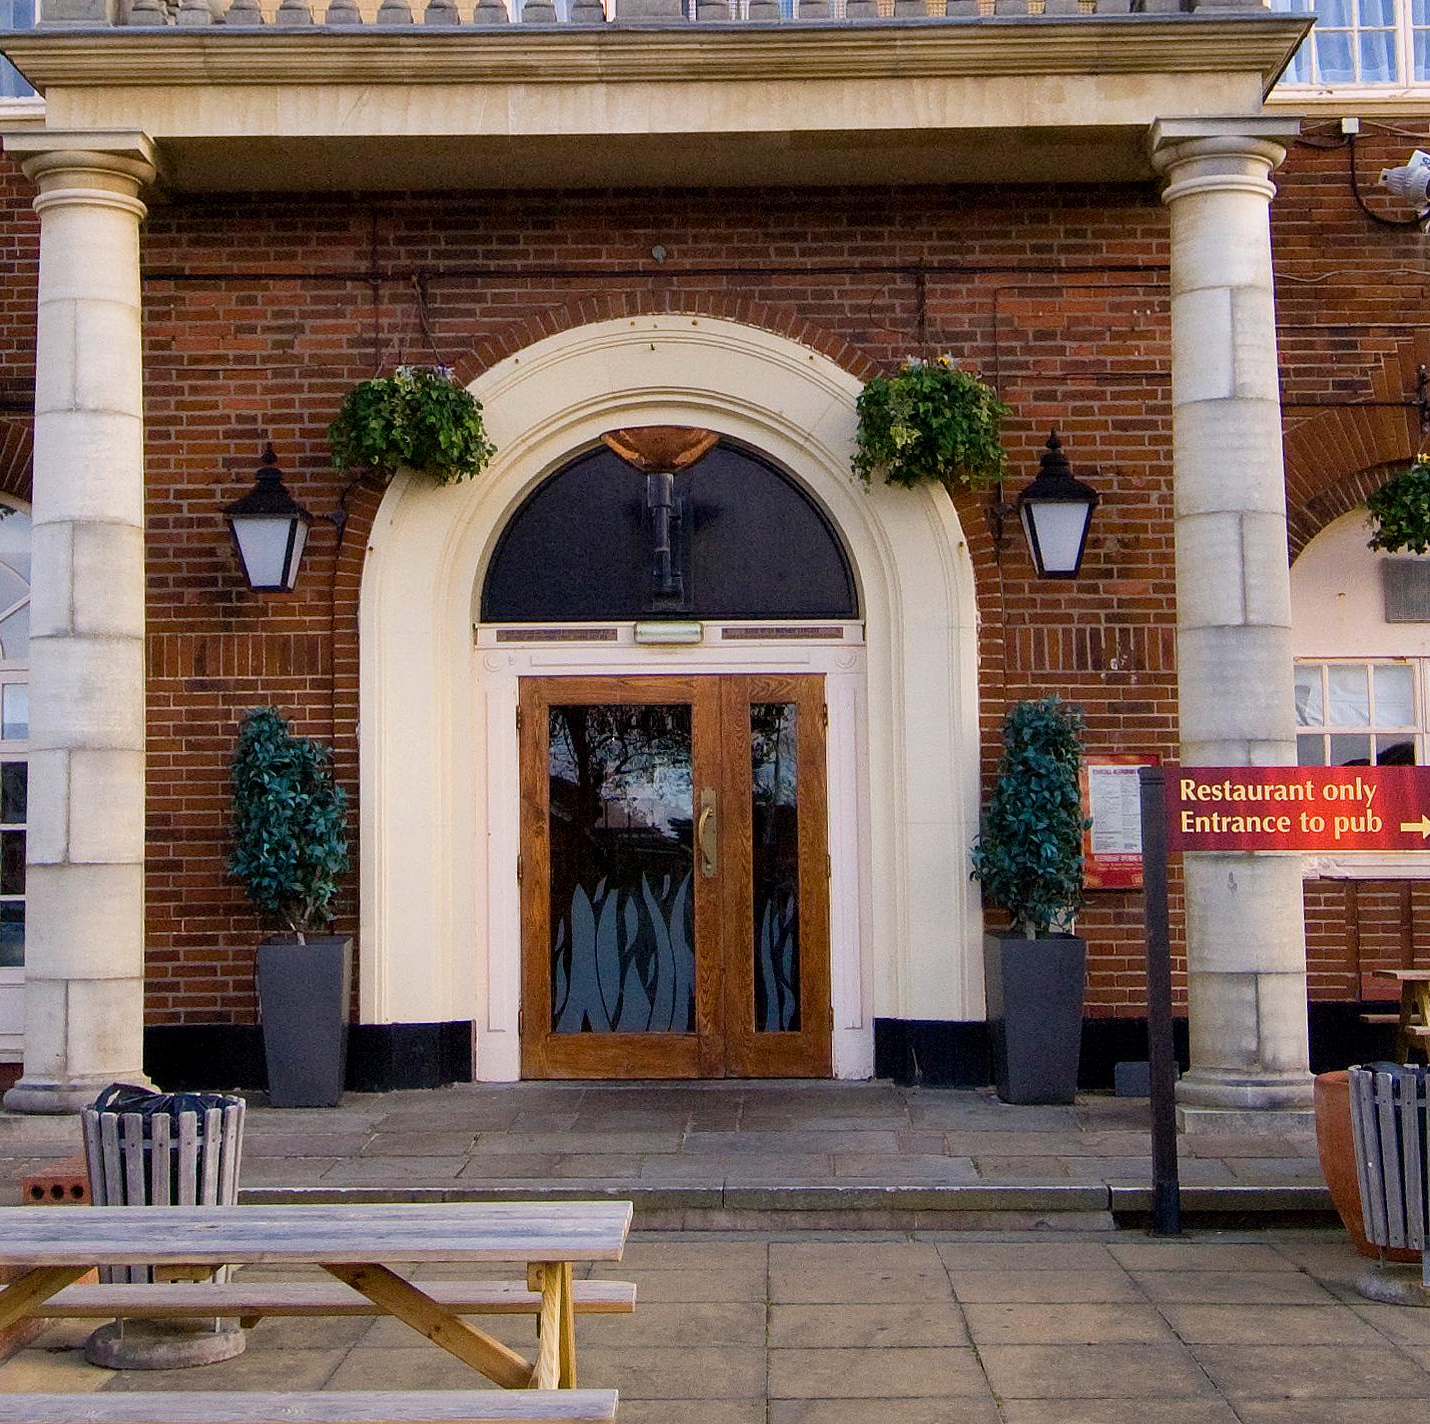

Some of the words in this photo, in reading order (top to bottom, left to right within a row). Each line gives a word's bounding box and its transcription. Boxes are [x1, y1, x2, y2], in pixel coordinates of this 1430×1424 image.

[1180, 779, 1315, 802] Restaurant
[1322, 776, 1377, 808] only
[1181, 810, 1291, 833] Entrance
[1299, 811, 1325, 833] to
[1334, 808, 1383, 840] pub
